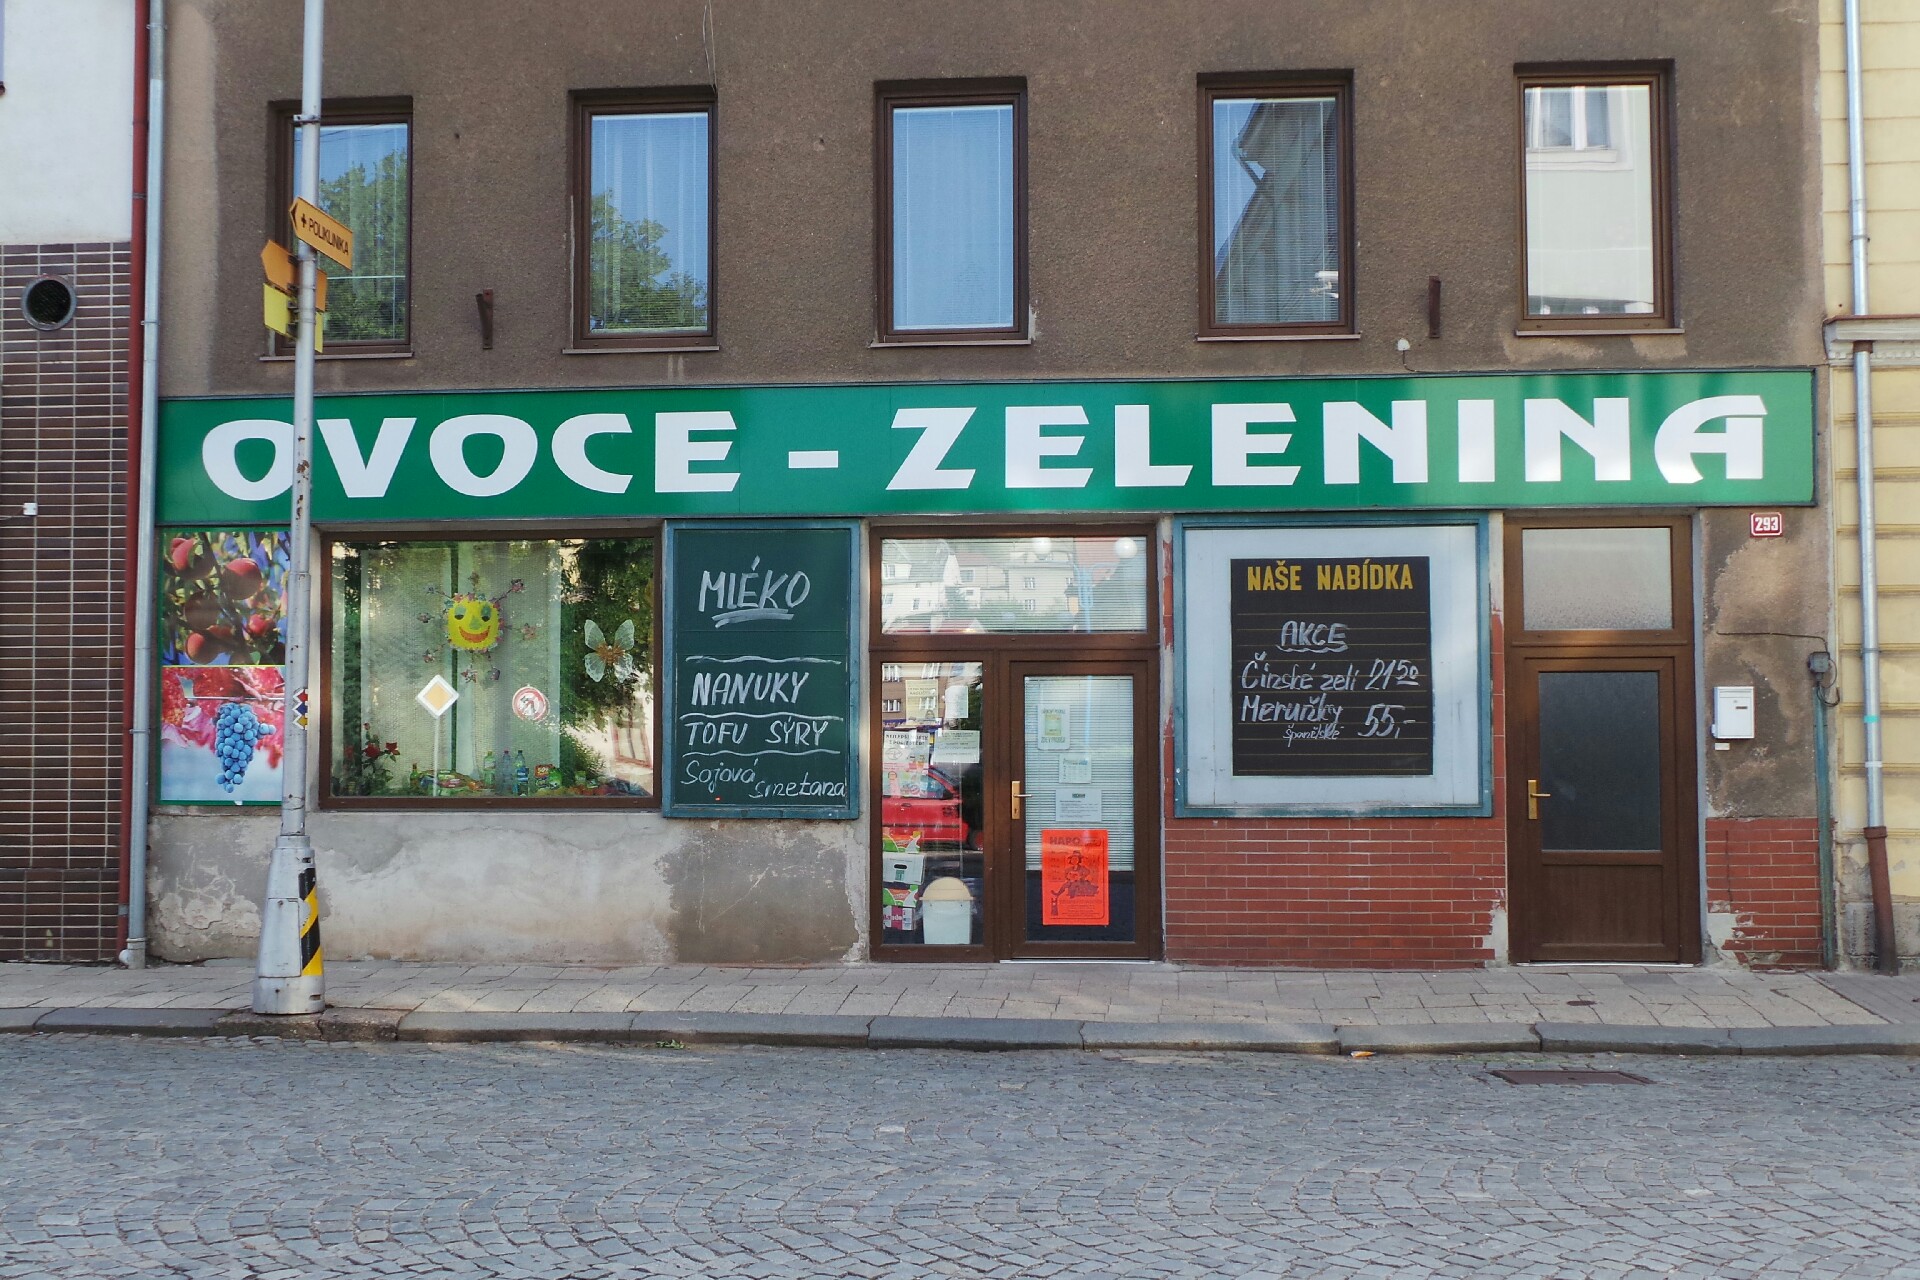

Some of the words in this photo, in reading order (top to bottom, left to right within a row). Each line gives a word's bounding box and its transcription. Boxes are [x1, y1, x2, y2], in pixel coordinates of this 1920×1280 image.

[309, 217, 349, 256] POLIKLINIKA
[202, 411, 741, 501] OVOCE
[885, 395, 1768, 490] ZELENINA
[1755, 516, 1779, 531] 293
[1247, 560, 1302, 591] NAŠE
[1317, 558, 1414, 591] NABÍDKA
[1281, 620, 1350, 647] AKCE
[691, 671, 810, 706] NANUKY
[1241, 651, 1316, 690] Čínské
[1320, 662, 1360, 691] zelí
[684, 721, 749, 746] TOFU
[765, 715, 828, 746] SÝRY
[680, 757, 759, 793] Sojová
